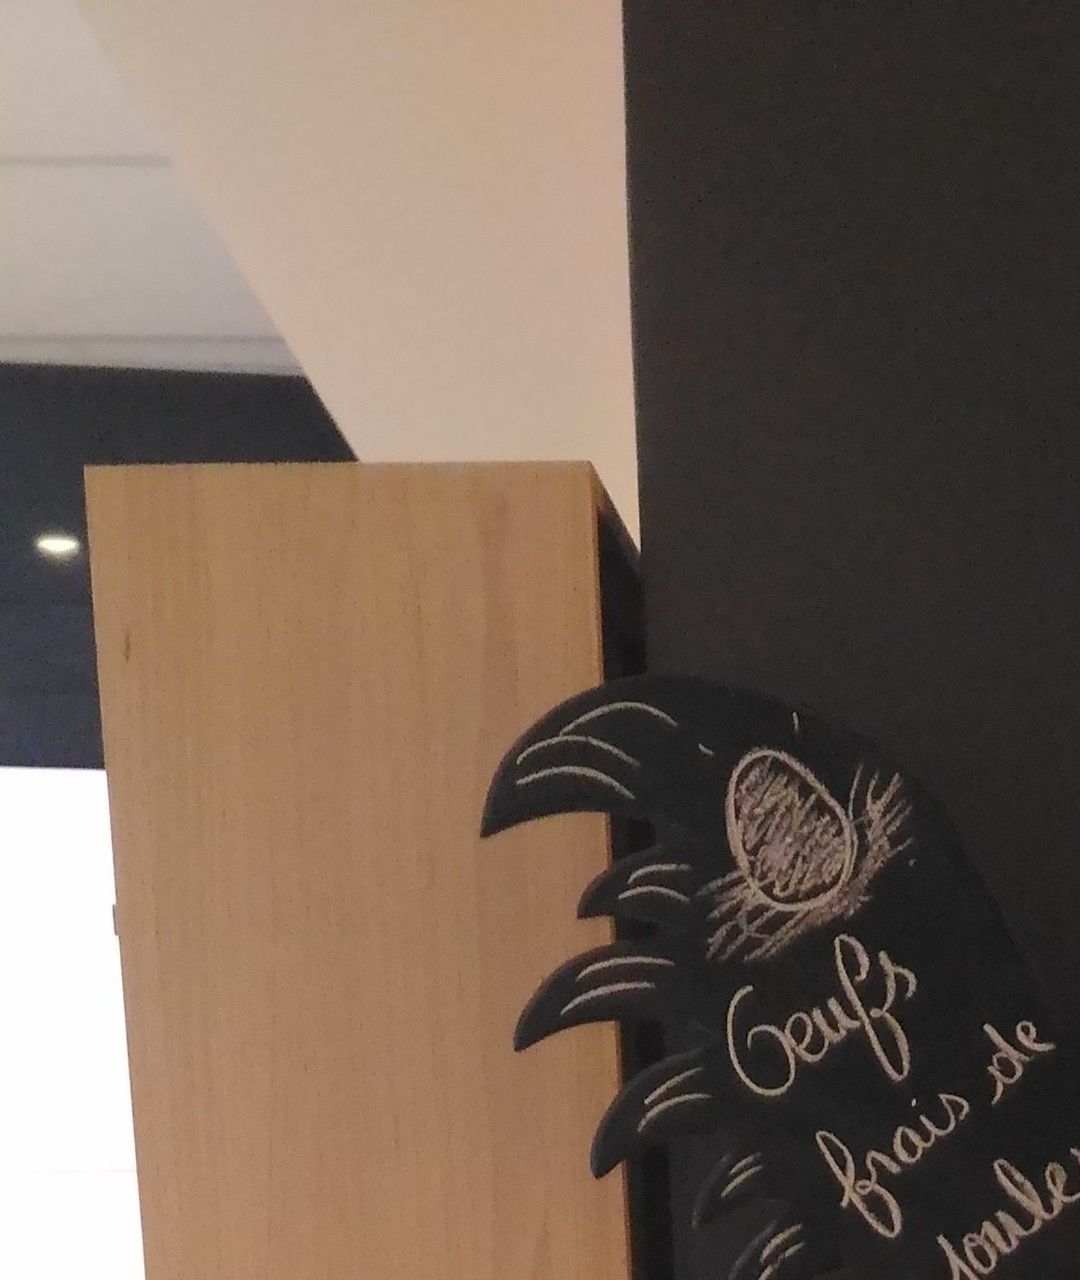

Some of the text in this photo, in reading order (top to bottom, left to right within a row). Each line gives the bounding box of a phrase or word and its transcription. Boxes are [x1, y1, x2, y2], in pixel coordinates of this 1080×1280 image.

[726, 934, 917, 1097] Oeufs
[816, 1020, 1055, 1239] frais de
